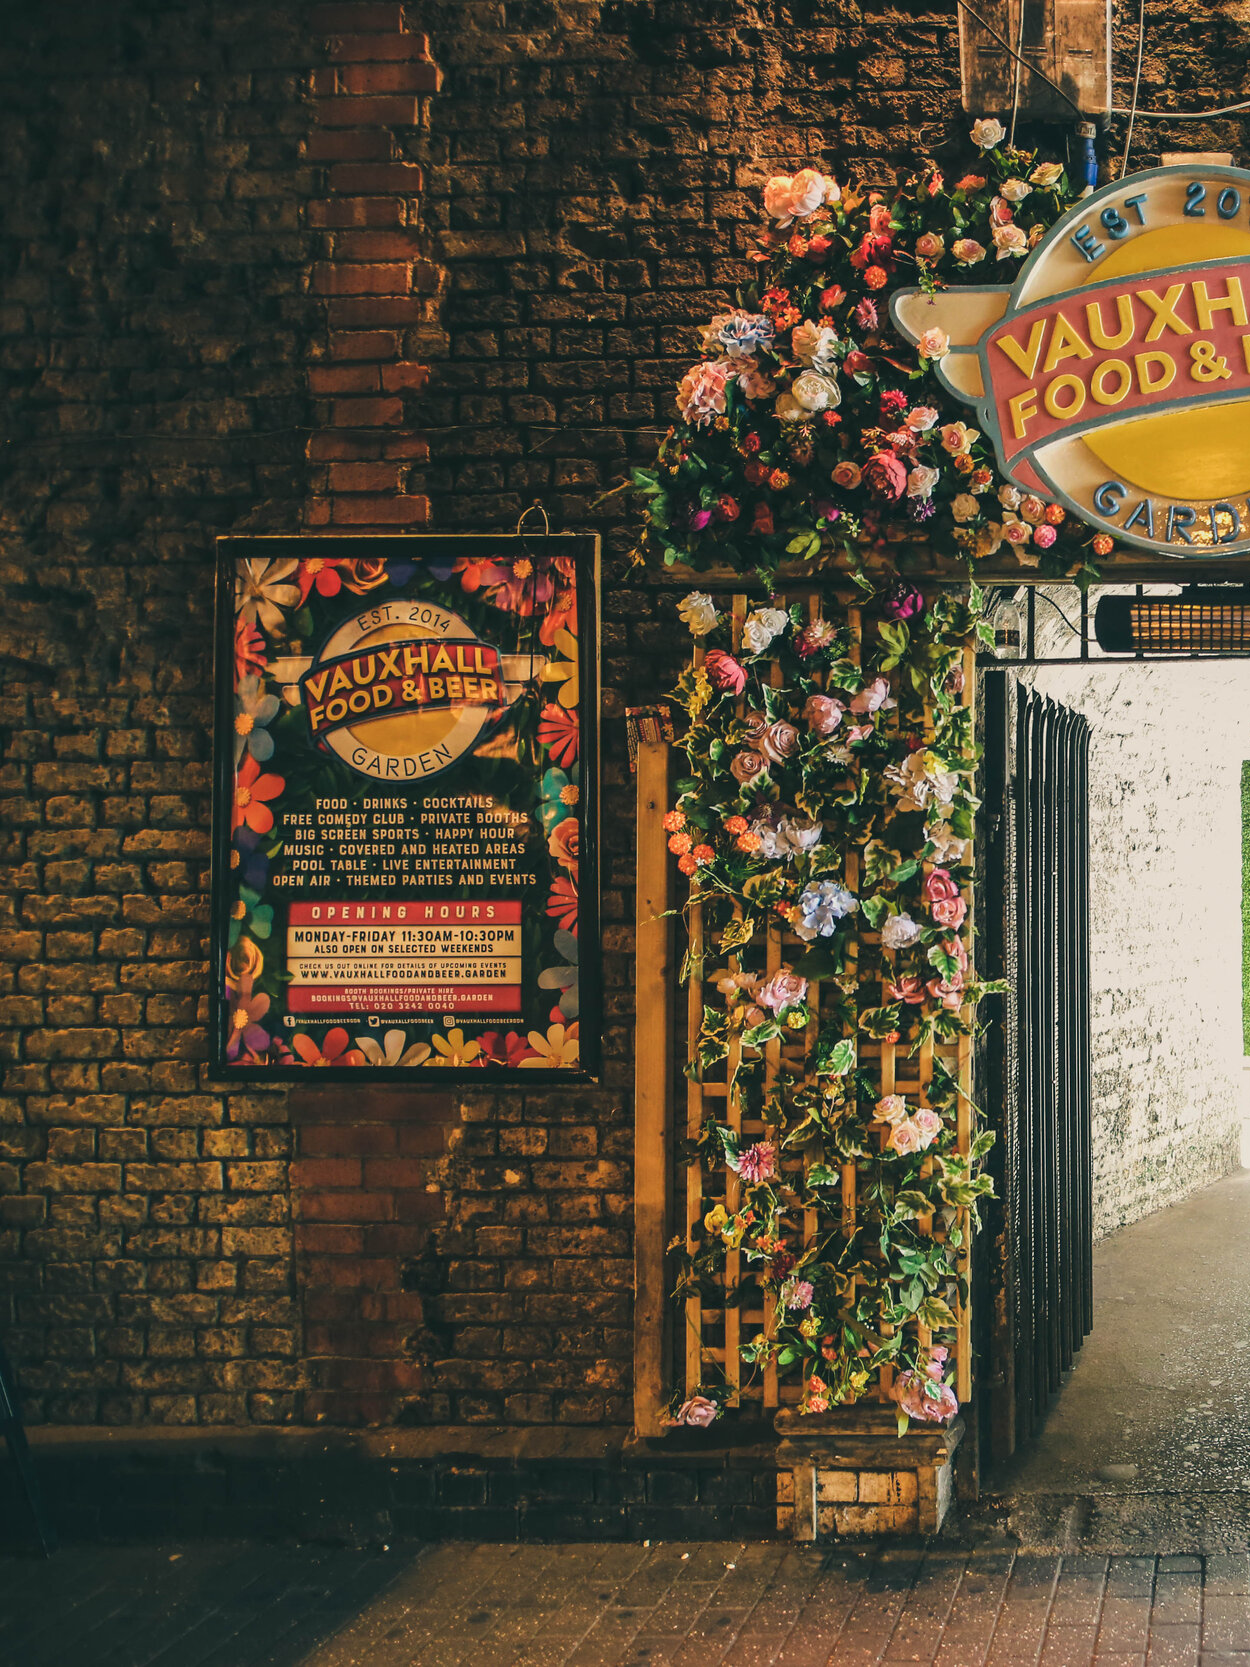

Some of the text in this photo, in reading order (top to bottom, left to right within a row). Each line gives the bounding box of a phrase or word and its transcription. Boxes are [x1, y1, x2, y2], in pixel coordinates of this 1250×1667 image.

[1070, 193, 1149, 262] EST
[1008, 351, 1177, 439] FOOD
[1189, 340, 1233, 384] &
[357, 606, 451, 633] EST. 2014
[304, 644, 492, 702] VAUXHALL
[311, 676, 498, 731] FOOD & BEER
[351, 742, 453, 778] GARDEN
[316, 796, 494, 810] FOOD DRINKS COCKTAILS
[283, 812, 528, 825] FREE COMEDY CLUB PRIVATE BOOTHS
[295, 828, 515, 840] BIG SCREEN SPORTS HAPPY HOUR
[284, 843, 526, 856] MUSIC COVERED AND HEATED AREAS
[292, 859, 516, 871] POOL TABLE LIVE ENTERTAINMENT
[273, 874, 537, 886] OPEN AIR THEMED PARTIES AND EVENTS
[312, 906, 495, 919] OPENING HOURS
[294, 930, 514, 942] MONDAY-FRIDAY 11:30AM-10:30PM
[314, 944, 494, 954] ALSO OPEN ON SELECTED WEEKENDS
[300, 970, 506, 979] WWW.VAUXHALLFOODANDBEER.GARDEN
[312, 994, 493, 1002] BOOKINGS@VAUXHALLFOODANDBEER.GARDEN
